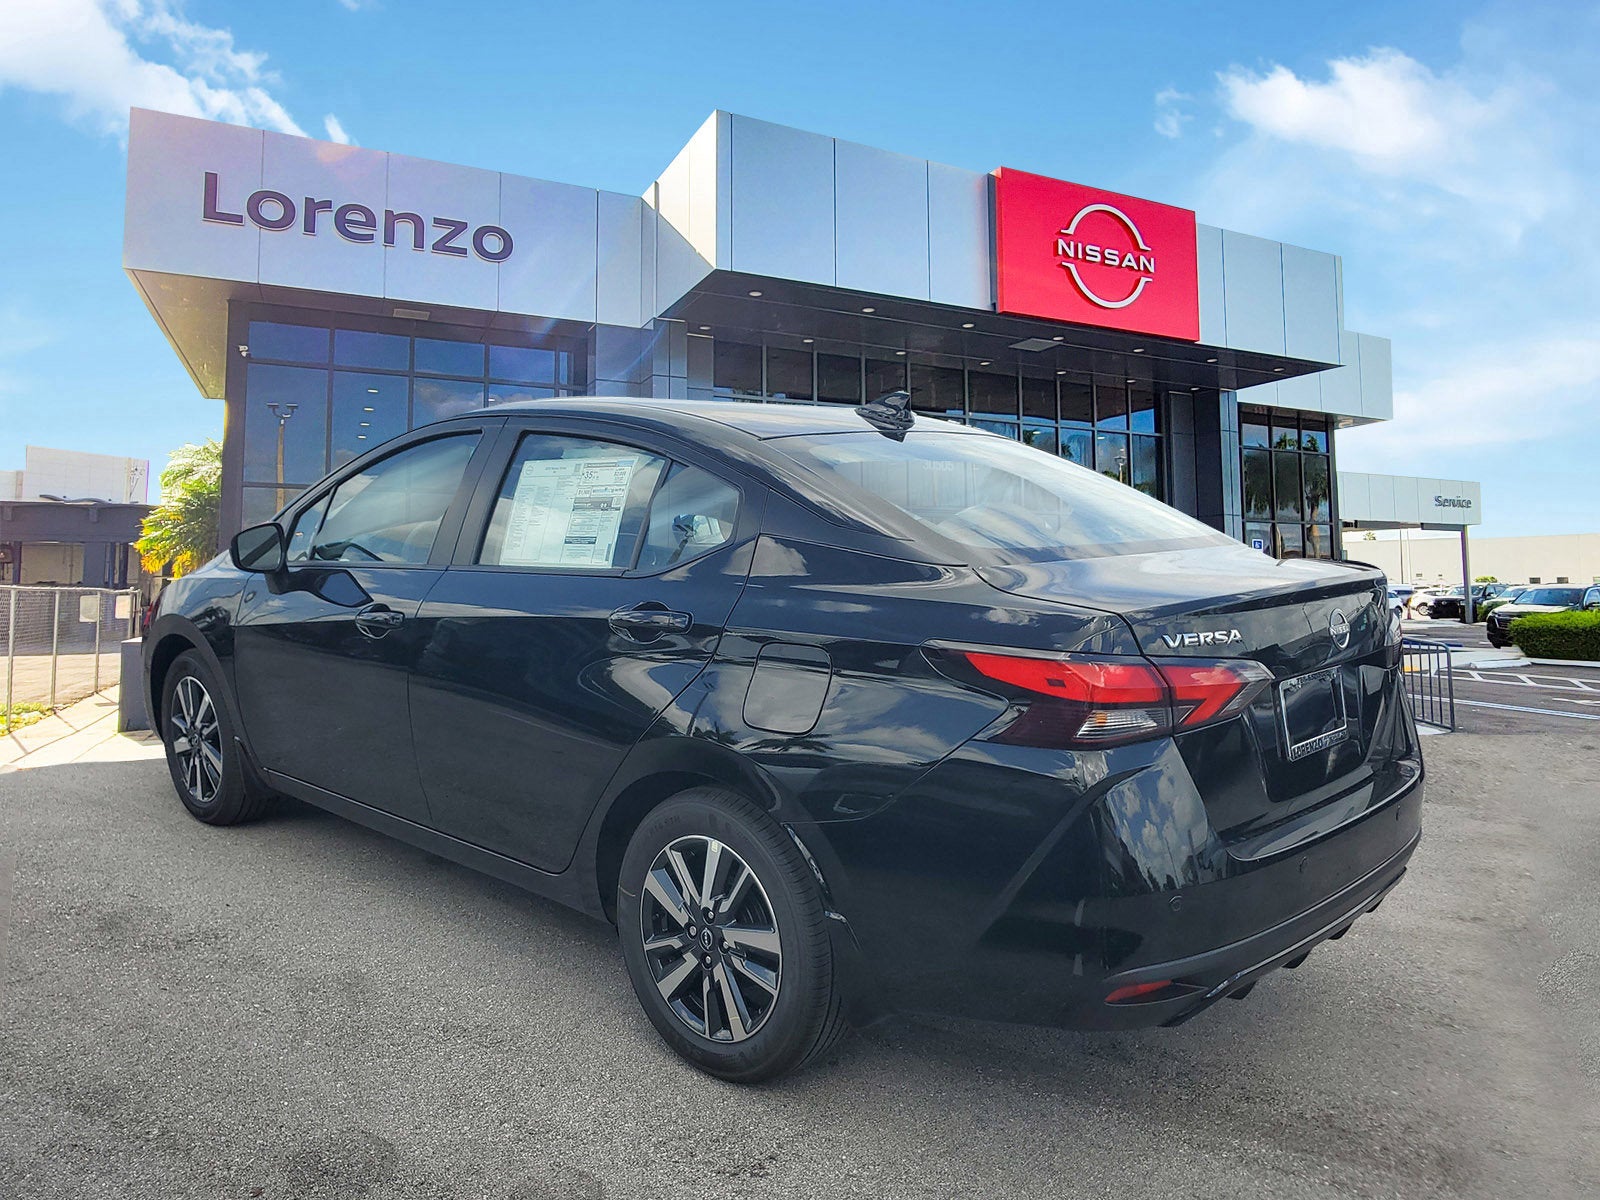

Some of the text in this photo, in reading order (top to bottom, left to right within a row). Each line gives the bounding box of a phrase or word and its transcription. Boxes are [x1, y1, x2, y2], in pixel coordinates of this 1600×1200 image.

[202, 171, 514, 262] Lorenzo
[1057, 238, 1155, 273] NISSAN
[1434, 495, 1472, 508] Service
[1163, 629, 1243, 649] VERSA
